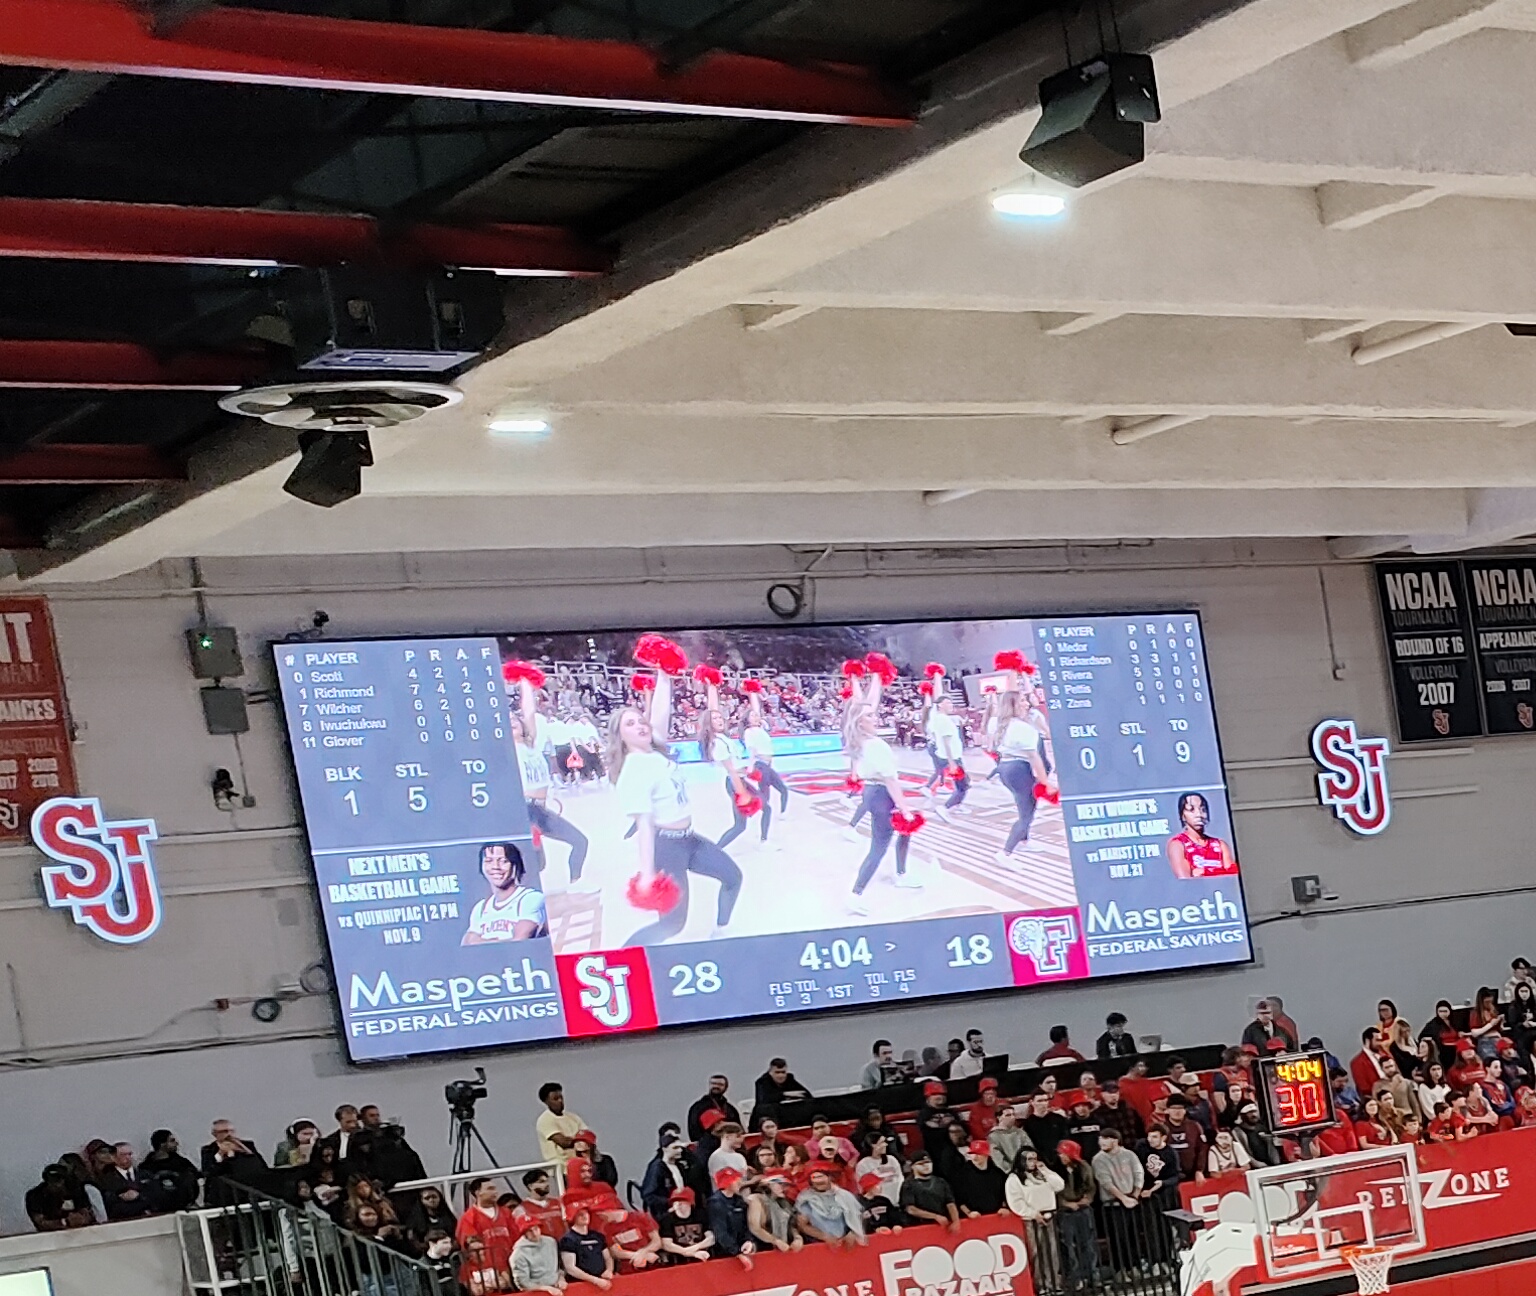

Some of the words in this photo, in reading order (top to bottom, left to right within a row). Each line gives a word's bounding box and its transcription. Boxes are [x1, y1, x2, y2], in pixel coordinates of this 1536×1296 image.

[1385, 571, 1457, 611] NCAA
[1391, 608, 1459, 627] TOURNAMENT
[306, 651, 359, 666] PLAYER
[1395, 637, 1434, 657] ROUND
[1435, 637, 1450, 654] OF
[1451, 636, 1465, 654] 16
[1408, 663, 1458, 681] VOLLEYBALL
[314, 685, 374, 700] Richmond
[1418, 682, 1456, 706] 2007
[1069, 724, 1098, 738] BLK
[1120, 722, 1146, 735] STL
[1168, 719, 1188, 732] TO
[1080, 747, 1096, 770] 0
[1132, 743, 1145, 766] 1
[1175, 741, 1191, 763] 9
[325, 766, 362, 783] BLK
[395, 764, 428, 778] STL
[462, 759, 486, 775] TO
[344, 790, 359, 816] 1
[408, 786, 428, 812] 5
[471, 782, 490, 807] 5
[328, 879, 419, 904] BASKETBALL
[420, 874, 460, 895] GAME
[1087, 890, 1238, 937] Maspeth
[1088, 938, 1169, 958] FEDERAL
[1169, 930, 1243, 948] SAVINGS
[668, 960, 722, 997] 28
[800, 936, 873, 971] 4:04
[946, 934, 994, 968] 18
[350, 958, 551, 1012] Maspeth
[826, 984, 853, 999] 1ST
[351, 1011, 457, 1037] FEDERAL
[462, 1002, 559, 1025] SAVINGS
[1276, 1058, 1322, 1082] 4:04
[1276, 1083, 1322, 1124] 30
